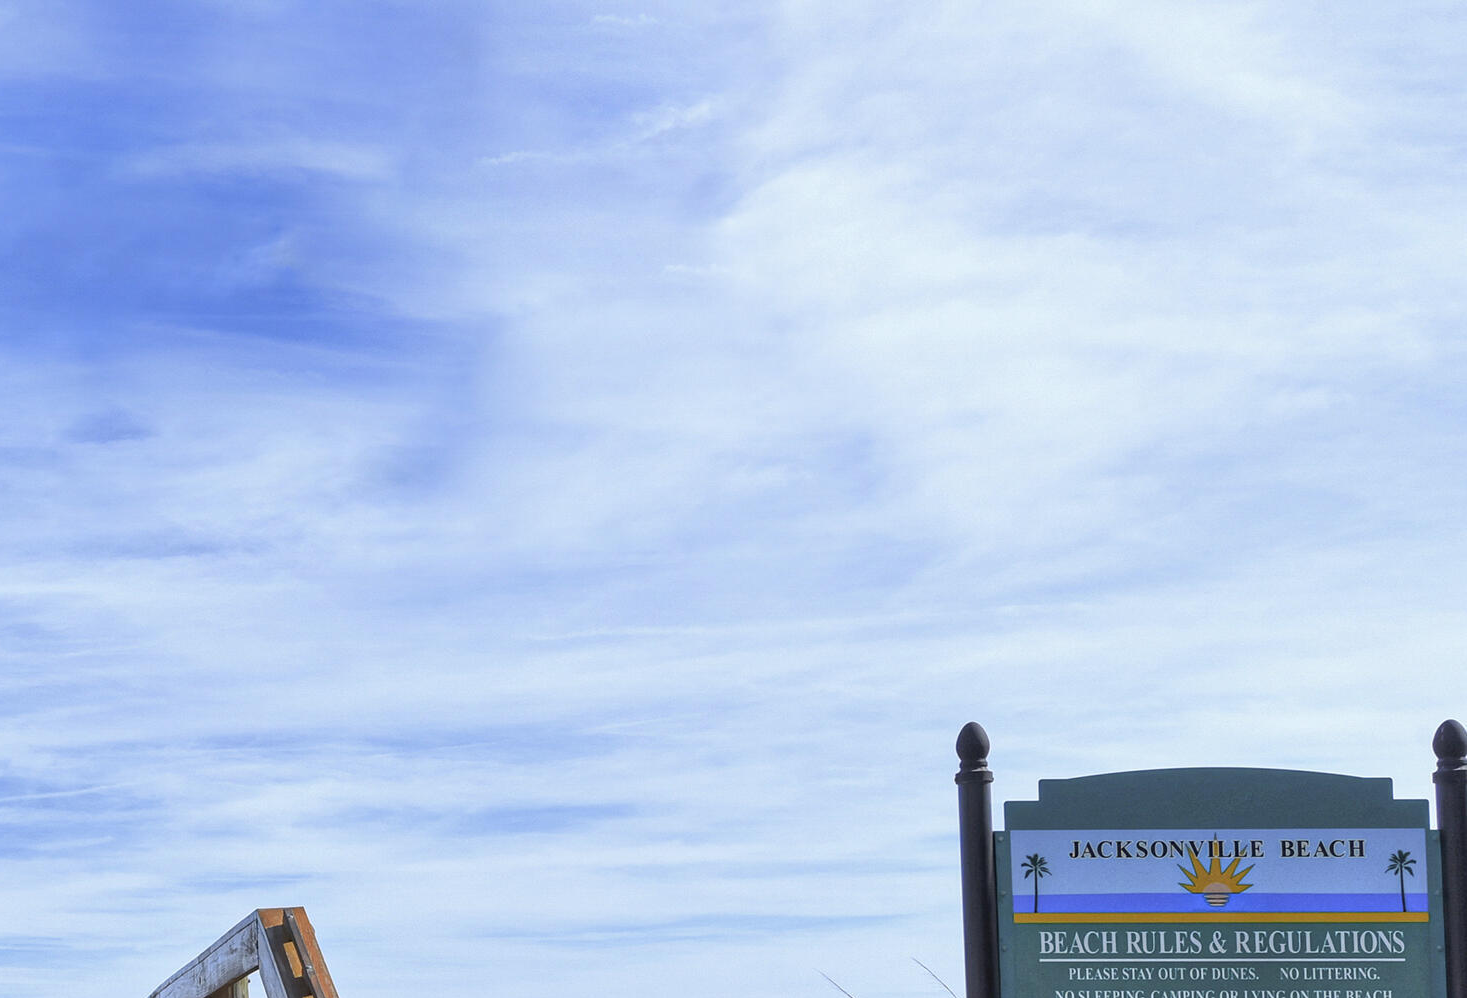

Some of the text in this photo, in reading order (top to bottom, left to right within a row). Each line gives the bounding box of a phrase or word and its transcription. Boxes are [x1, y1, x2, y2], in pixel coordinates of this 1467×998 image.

[1068, 839, 1366, 859] JACKSONVILLE BEACH
[1039, 930, 1405, 954] BEACH RULES & REGULATIONS
[1068, 967, 1380, 980] PLEASE STAY OUT OF DUNES. NO LITTERING.
